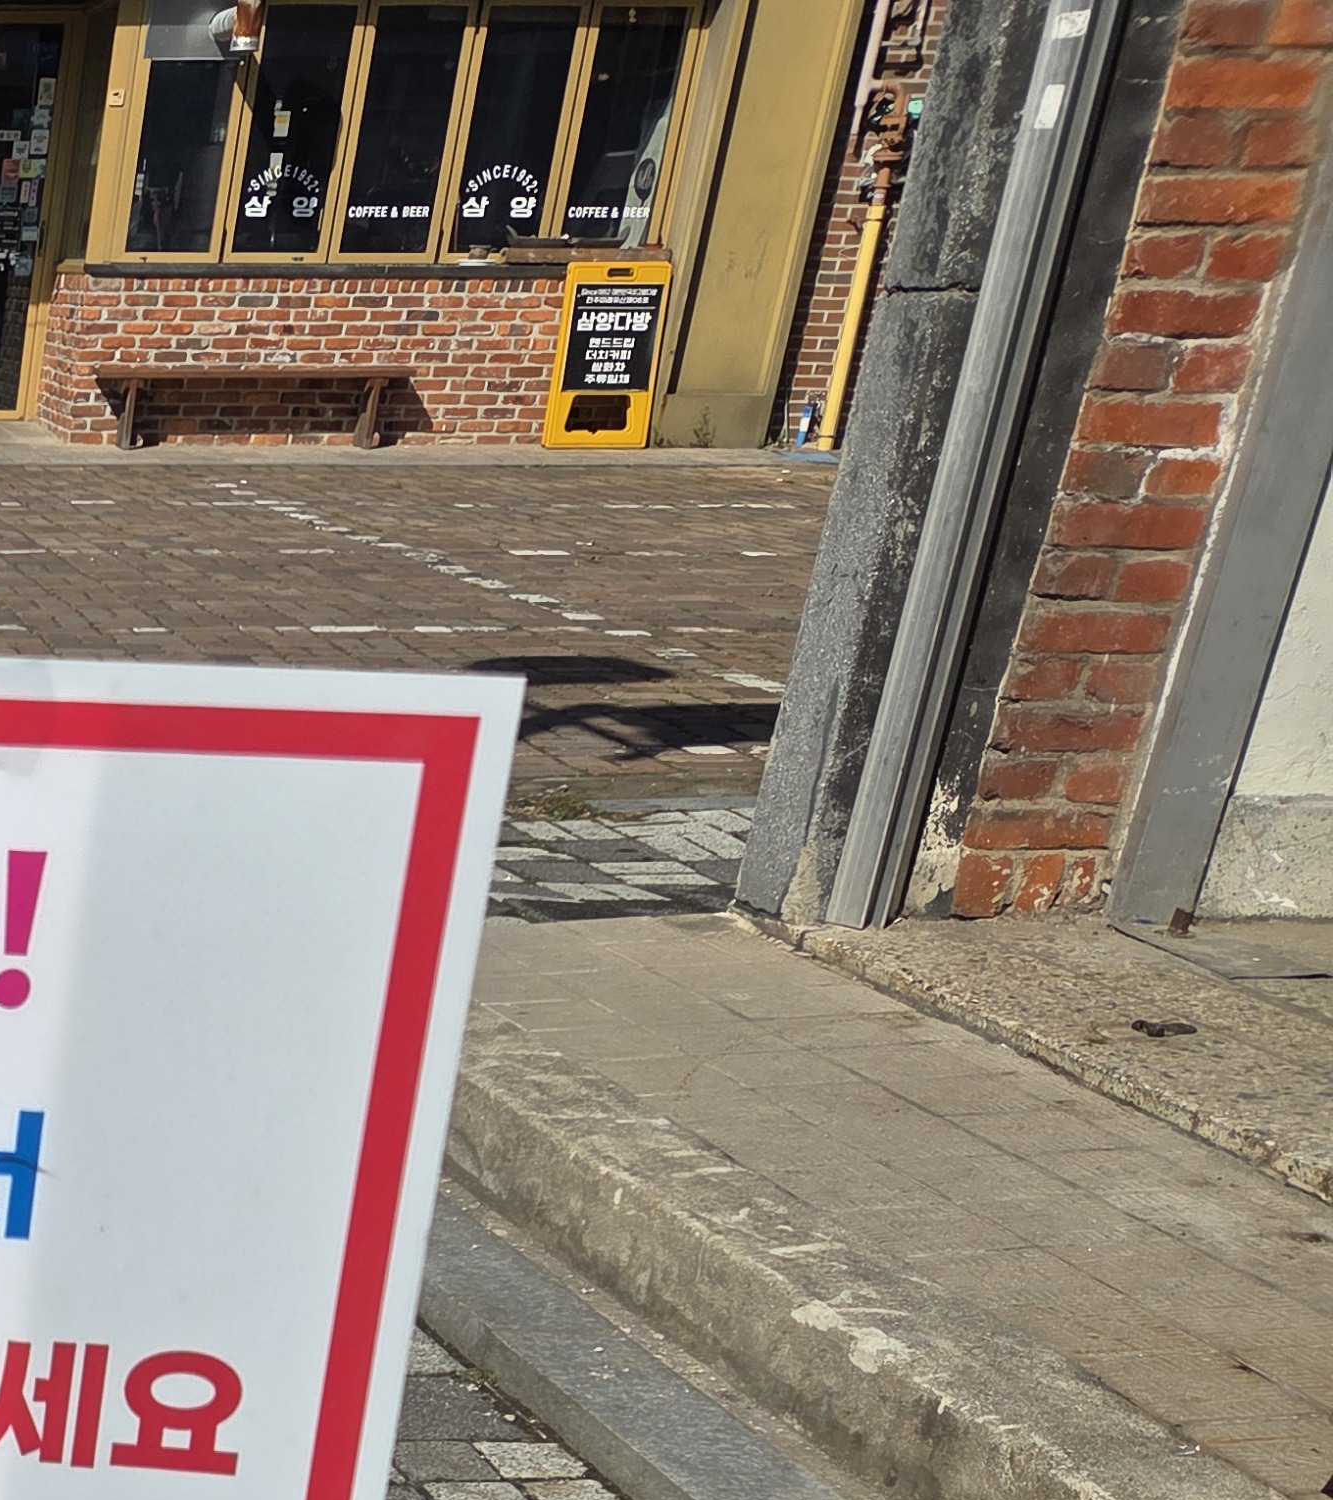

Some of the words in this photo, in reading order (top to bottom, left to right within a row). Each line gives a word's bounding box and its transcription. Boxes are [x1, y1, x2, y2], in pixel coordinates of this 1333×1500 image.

[348, 205, 389, 219] COFFEE
[402, 205, 430, 218] BEER
[568, 206, 610, 219] COFFEE
[622, 206, 650, 219] BEER
[576, 311, 653, 332] 삼양다방
[584, 350, 632, 361] 더치커피
